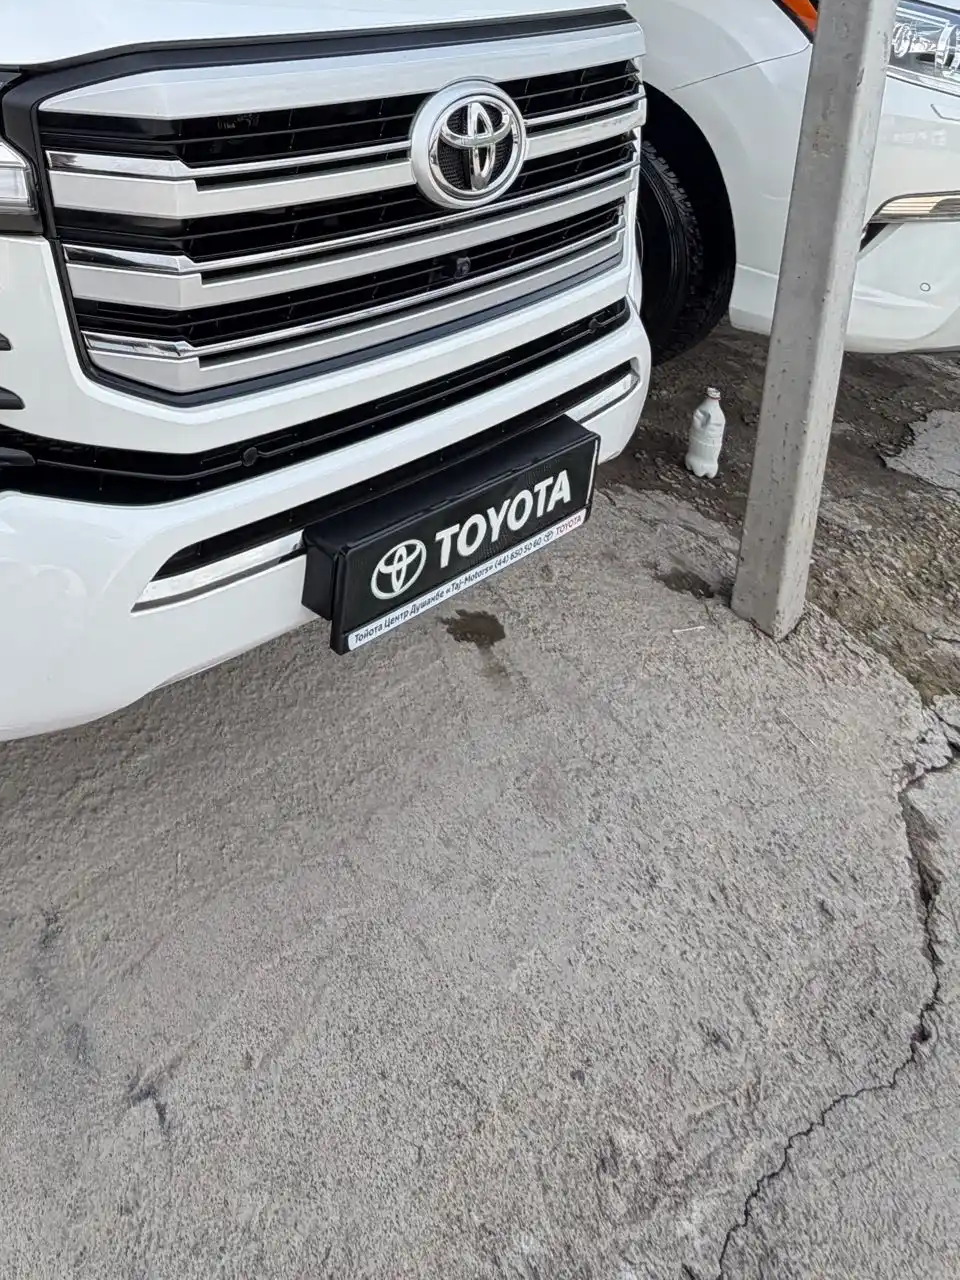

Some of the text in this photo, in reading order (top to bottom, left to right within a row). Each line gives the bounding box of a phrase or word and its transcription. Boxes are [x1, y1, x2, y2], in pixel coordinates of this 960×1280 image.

[435, 470, 571, 568] TOYOTA
[354, 624, 383, 643] Тойота
[410, 589, 444, 616] Душанбе
[555, 515, 581, 534] TOYOTA
